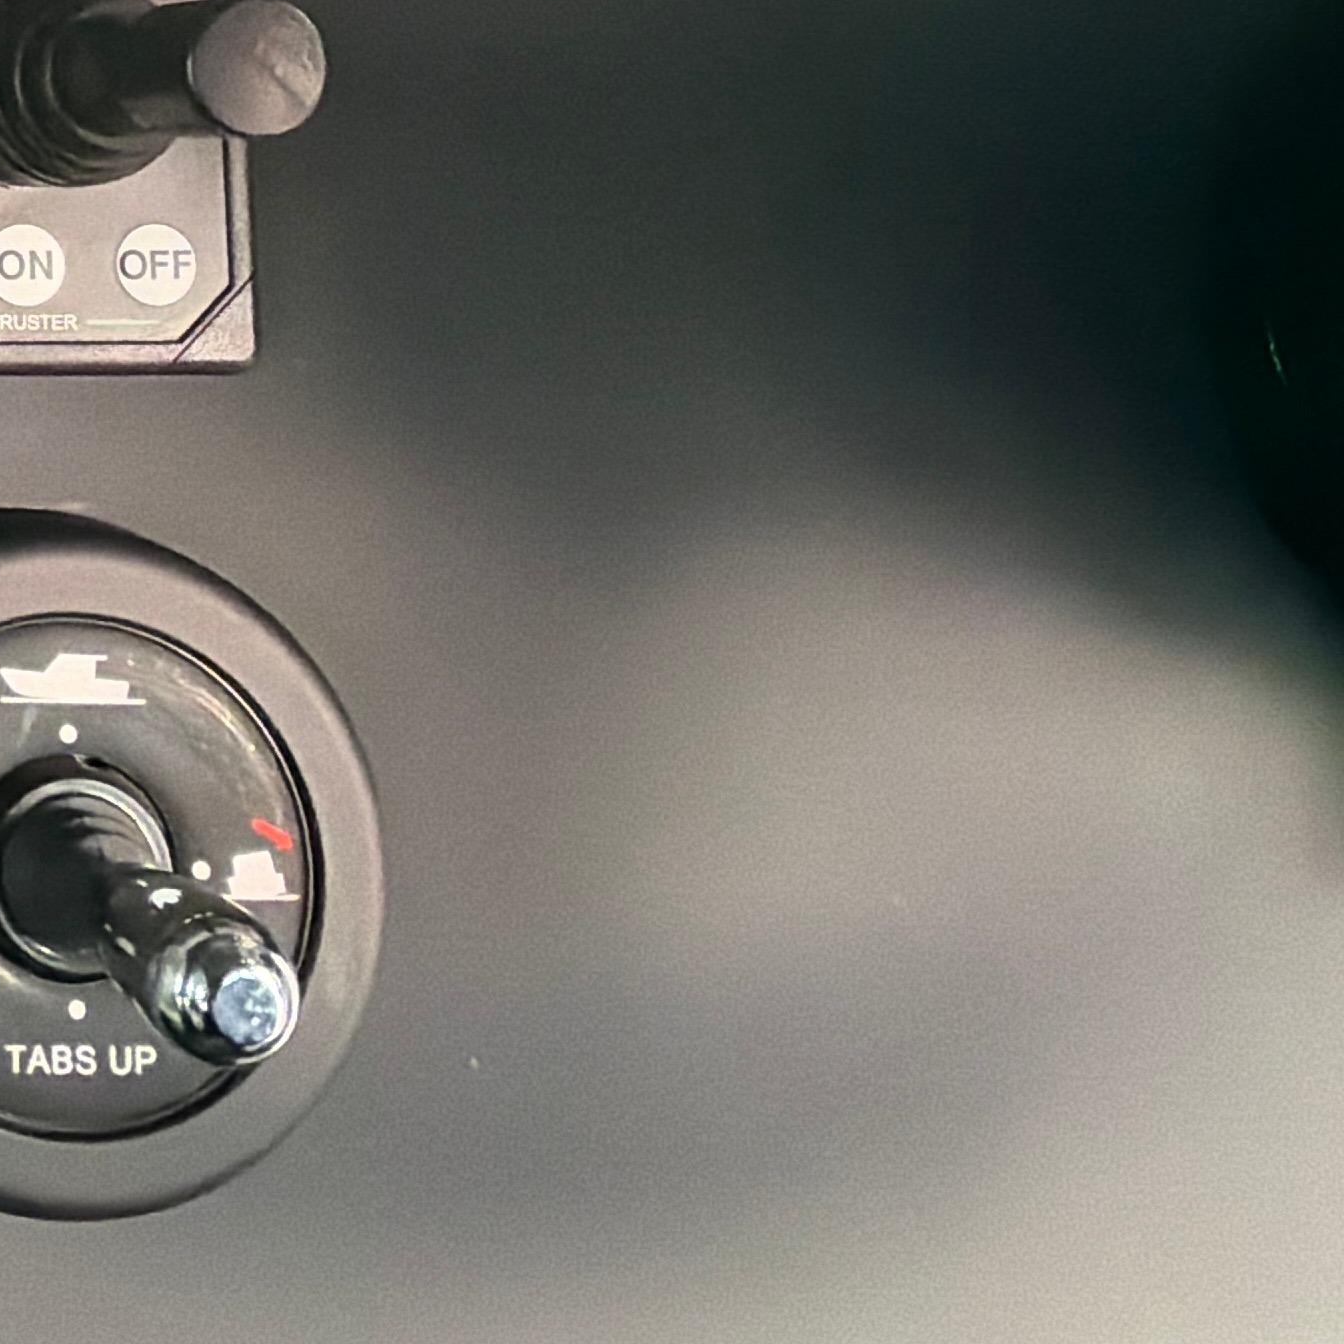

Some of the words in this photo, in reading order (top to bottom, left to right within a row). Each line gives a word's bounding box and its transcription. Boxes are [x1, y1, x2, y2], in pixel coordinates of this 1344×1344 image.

[119, 249, 193, 281] OFF
[5, 1043, 98, 1076] TABS
[108, 1043, 157, 1076] UP
